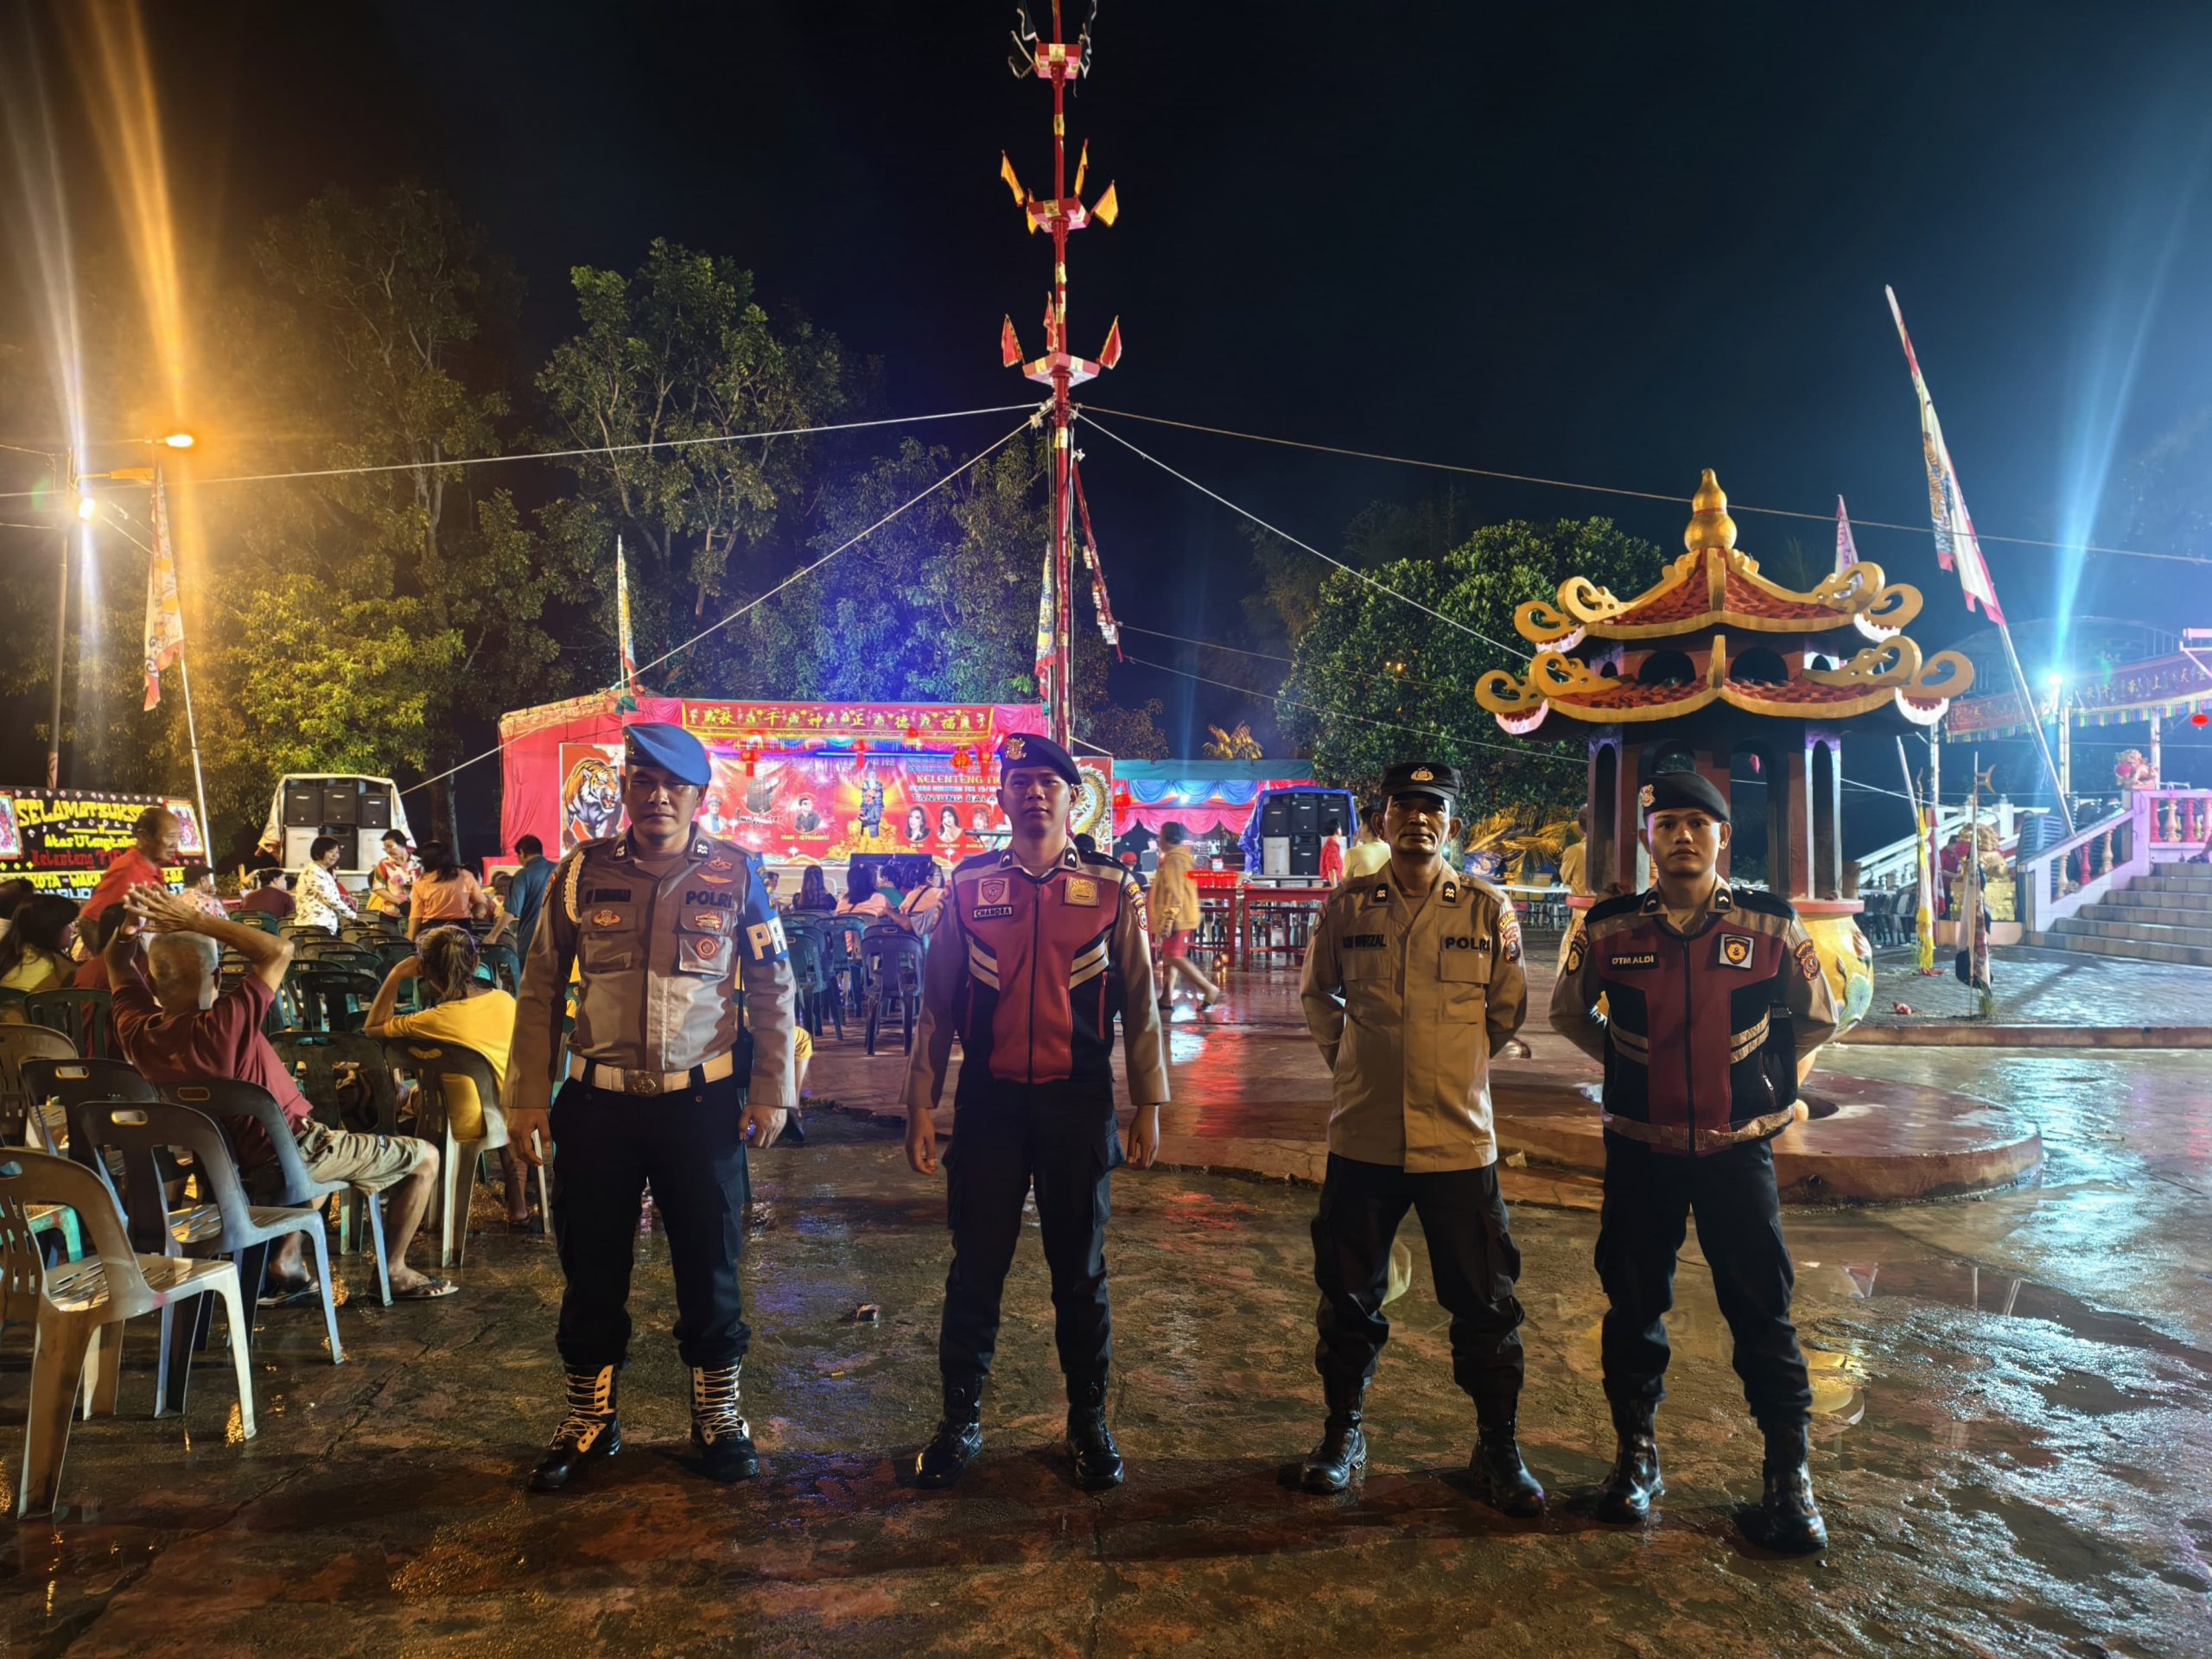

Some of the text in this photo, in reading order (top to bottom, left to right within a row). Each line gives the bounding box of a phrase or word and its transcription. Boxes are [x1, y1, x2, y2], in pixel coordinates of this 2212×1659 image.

[917, 775, 982, 784] KELENTENG
[912, 794, 996, 803] TANJUNG BALA
[685, 890, 732, 907] POLRI
[975, 906, 1011, 918] CHANDRA
[1445, 937, 1491, 951] POLRI
[1632, 955, 1654, 964] ALDI
